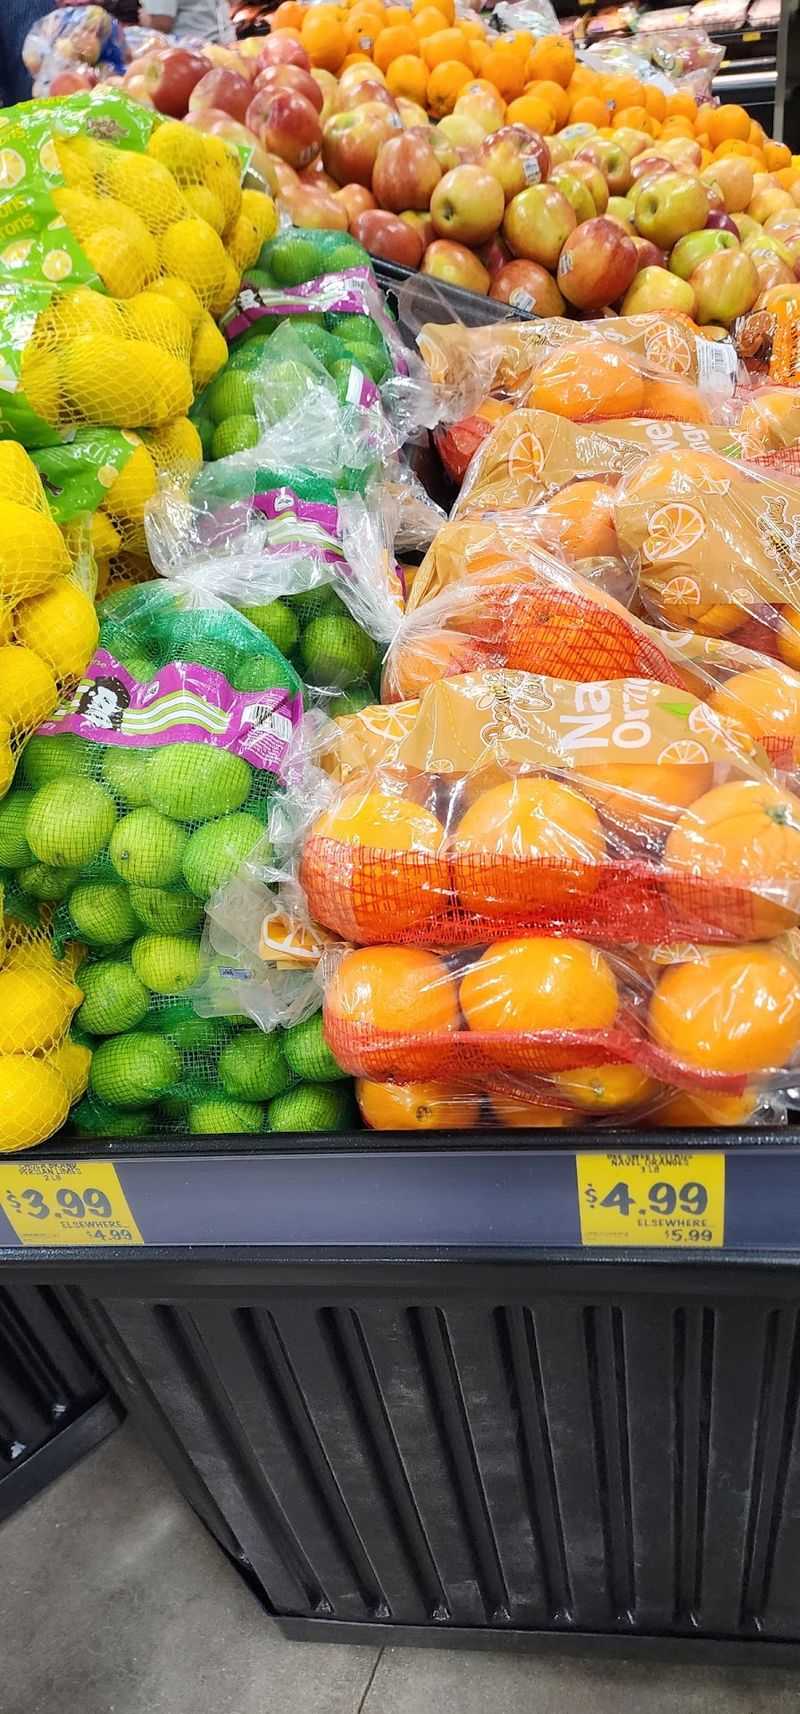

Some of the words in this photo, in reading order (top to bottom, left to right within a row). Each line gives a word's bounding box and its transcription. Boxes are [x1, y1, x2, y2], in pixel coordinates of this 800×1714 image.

[6, 1187, 113, 1220] $3.99
[584, 1181, 709, 1217] $4.99
[86, 1229, 132, 1241] $4.99
[664, 1229, 713, 1242] $5.99
